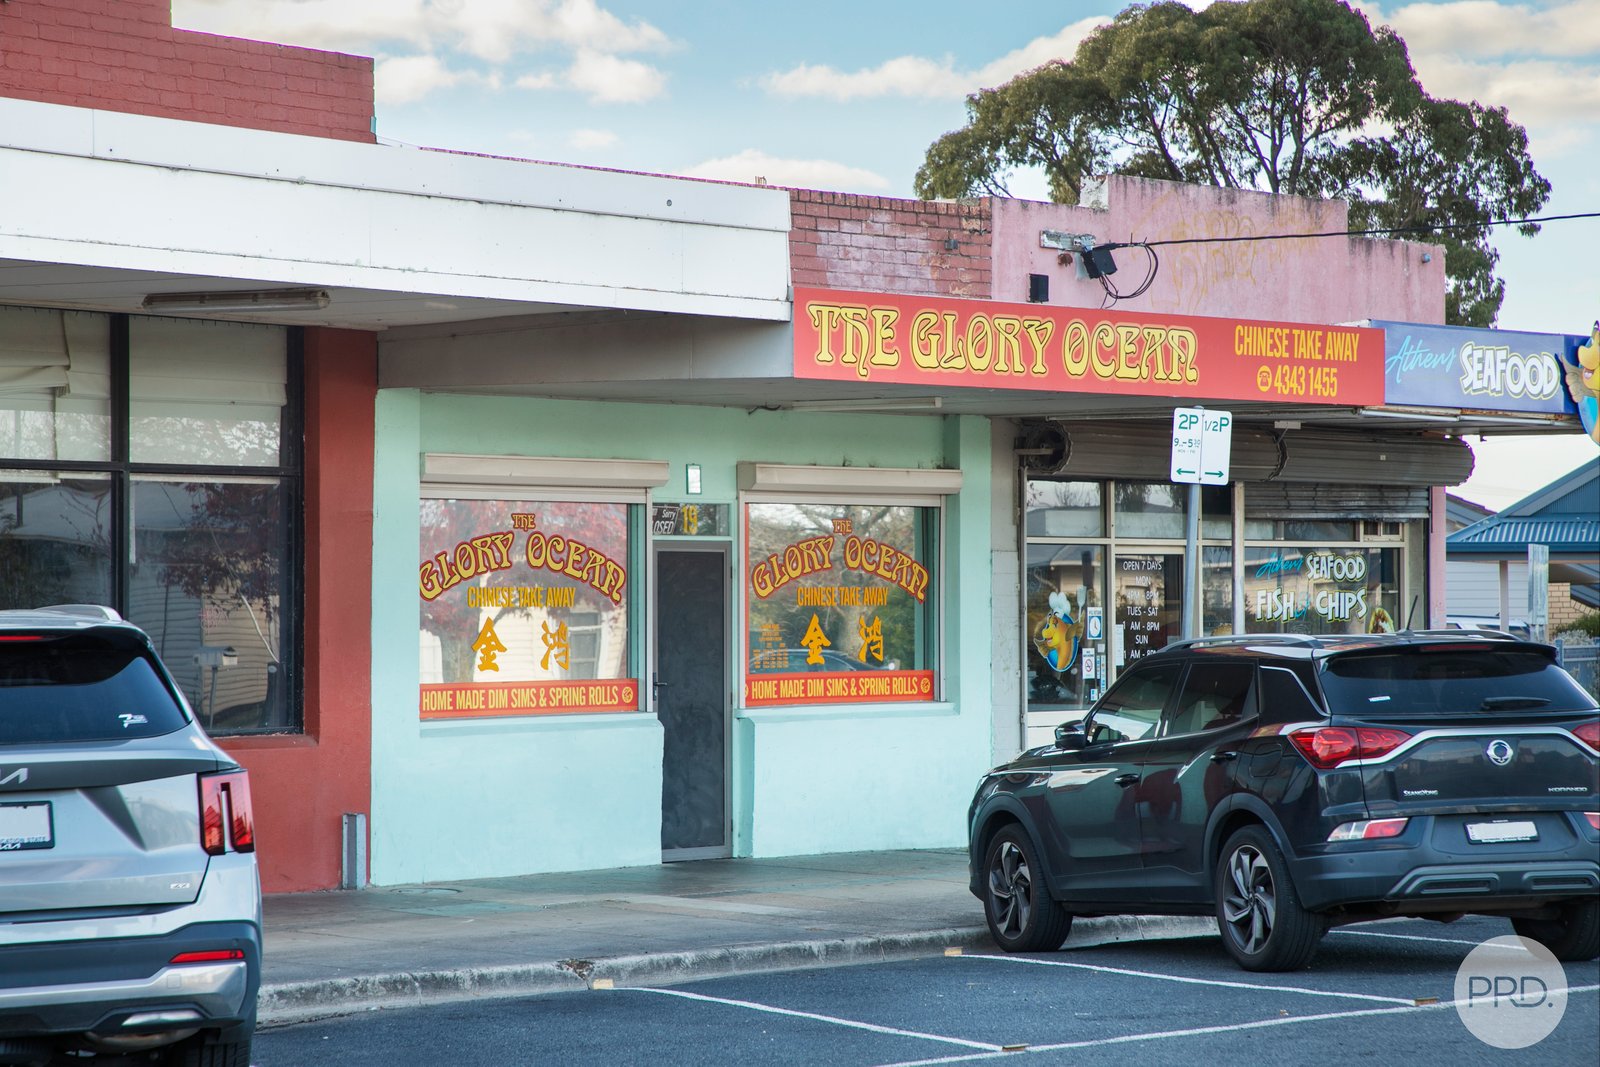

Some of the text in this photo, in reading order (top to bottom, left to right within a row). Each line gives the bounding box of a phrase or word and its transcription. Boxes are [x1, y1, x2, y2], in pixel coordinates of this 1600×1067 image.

[807, 303, 1199, 382] THE GLORY OCEAN
[1234, 325, 1360, 363] CHINESE TAKE AWAY
[1273, 364, 1338, 397] 4343 1455
[1460, 340, 1561, 400] SEAFOOD
[1178, 414, 1199, 430] 2P
[511, 513, 536, 531] THE
[661, 509, 676, 520] Sorry
[681, 505, 698, 535] 19
[653, 520, 675, 534] OSED
[832, 518, 852, 536] THE
[419, 531, 627, 606] GLORY OCEAN
[752, 535, 930, 605] GLORY OCEAN
[1122, 560, 1162, 571] OPEN 7 DAYS
[1306, 552, 1367, 581] SEAFOOD
[1135, 575, 1151, 586] MON
[467, 586, 577, 608] CHINESE TAKE AWAY
[797, 586, 889, 607] CHINESE TAKE AWAY
[1145, 590, 1159, 601] 8PM
[1256, 588, 1295, 622] FISH
[1315, 588, 1368, 622] CHIPS
[1126, 606, 1142, 616] TUES
[1147, 606, 1159, 616] SAT
[1130, 621, 1141, 631] AM
[1146, 621, 1160, 632] 8PM
[1135, 634, 1149, 645] SUN
[1130, 649, 1141, 659] AM
[422, 685, 619, 711] HOME MADE DIM SIMS & SPRING ROLLS
[751, 676, 919, 700] HOME MADE DIM SIMS & SPRING ROLLS
